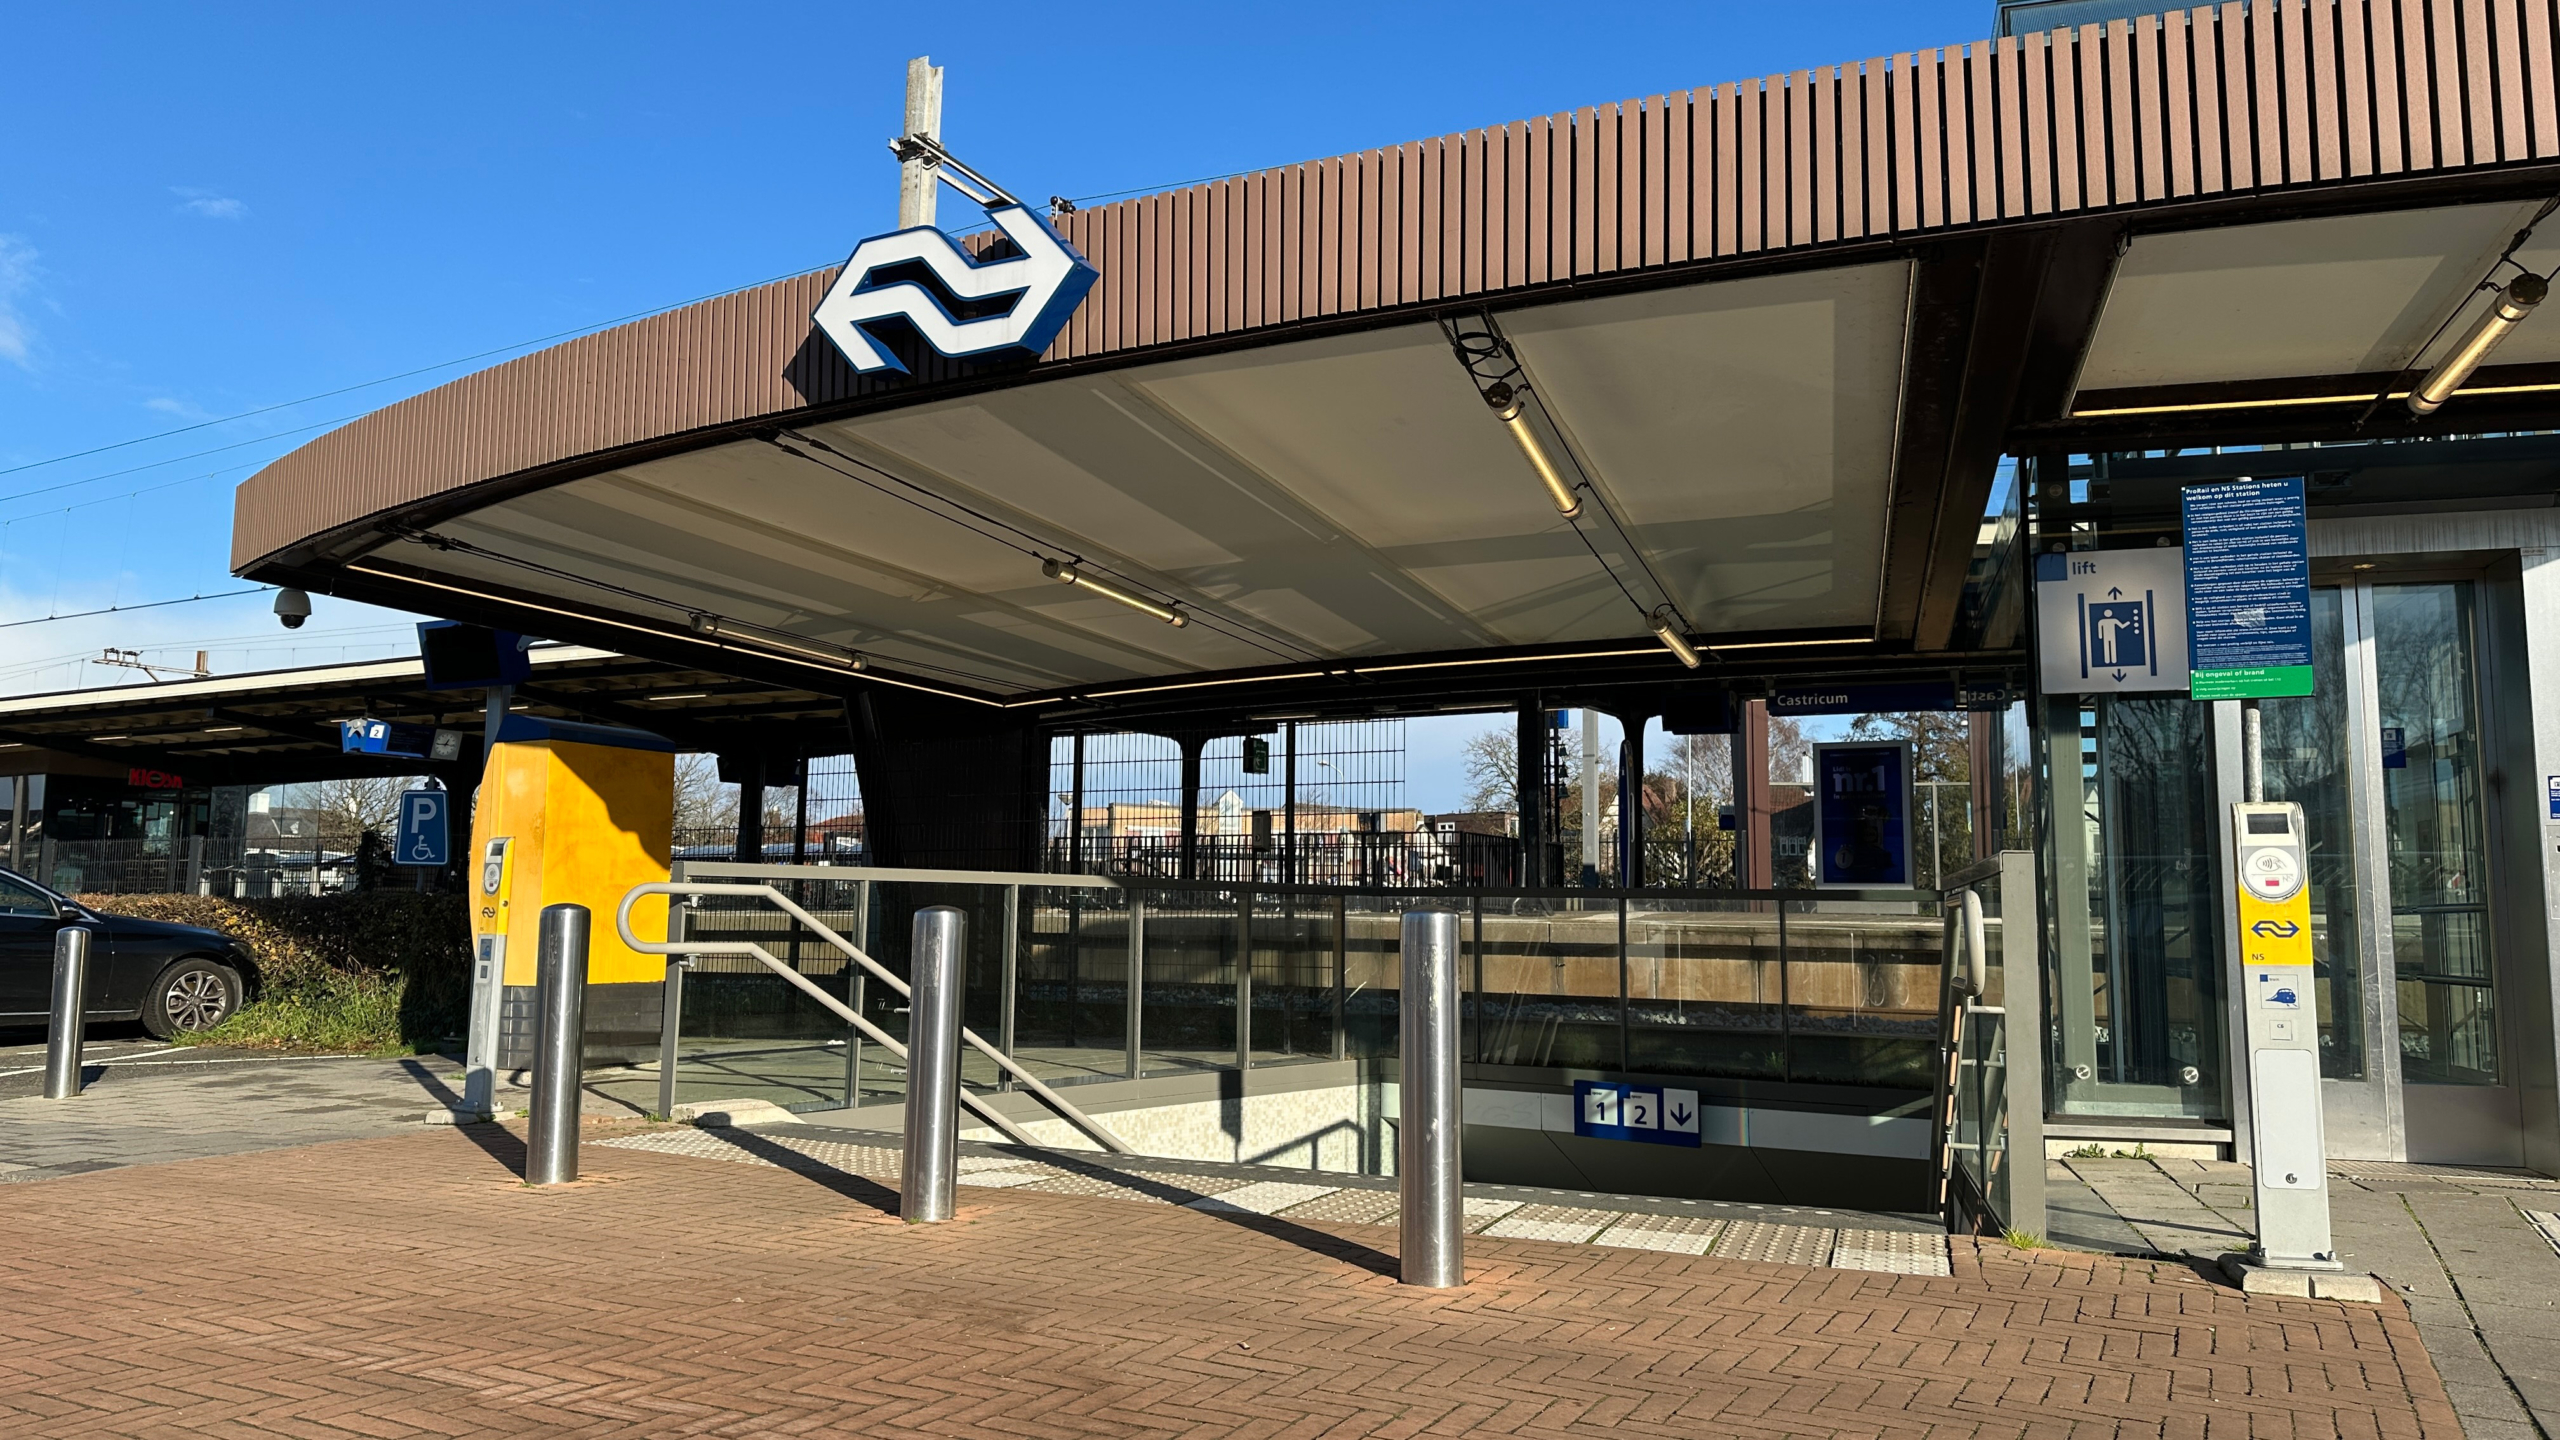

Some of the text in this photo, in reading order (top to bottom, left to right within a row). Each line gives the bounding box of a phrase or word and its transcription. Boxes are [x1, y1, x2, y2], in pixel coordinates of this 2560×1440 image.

[2186, 487, 2210, 495] ProRail
[2232, 483, 2261, 491] Stations
[2262, 481, 2282, 489] heten
[2186, 492, 2213, 501] welkom
[2072, 561, 2096, 575] lift
[2195, 670, 2204, 679] Bij
[2205, 670, 2233, 679] ongeval
[2234, 669, 2243, 677] of
[1777, 692, 1849, 707] Castricum
[373, 729, 379, 737] 2
[1832, 765, 1886, 793] nr.1
[411, 797, 437, 834] P
[2251, 953, 2265, 961] NS
[1596, 1102, 1605, 1121] 1
[1634, 1105, 1647, 1125] 2
